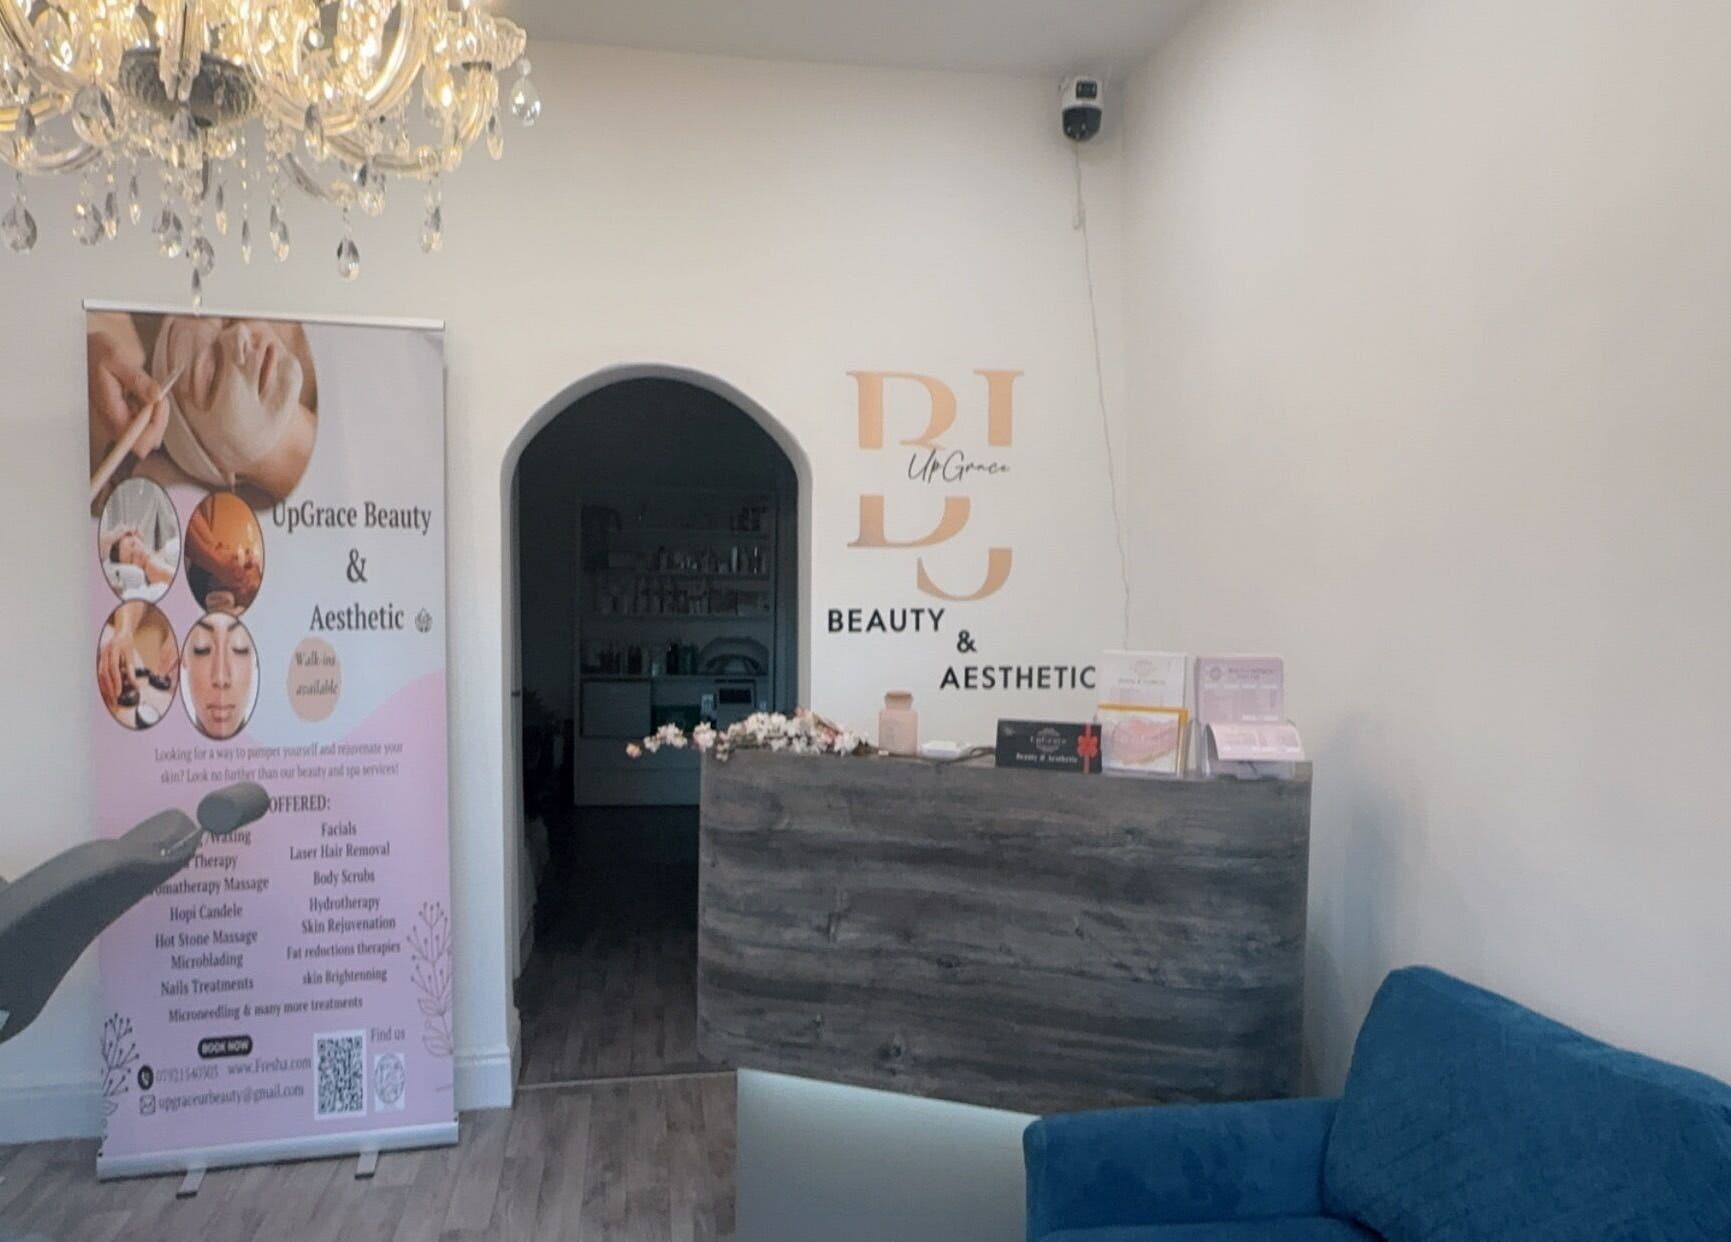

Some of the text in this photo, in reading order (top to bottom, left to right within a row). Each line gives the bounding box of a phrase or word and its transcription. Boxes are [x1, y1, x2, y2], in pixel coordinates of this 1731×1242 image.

[908, 448, 1010, 484] UpGrace
[272, 500, 432, 536] UpGrace Beauty
[346, 548, 368, 583] &
[309, 602, 404, 631] Aesthetic
[828, 608, 945, 632] BEAUTY
[956, 630, 978, 653] &
[940, 666, 1096, 690] AESTHETIC
[154, 747, 193, 764] Looking
[321, 820, 357, 837] Facials
[289, 840, 390, 861] Laser Hair Removal
[194, 854, 239, 871] Therapy
[224, 876, 270, 893] Massage
[313, 867, 376, 888] Body Scrubs
[309, 895, 380, 913] Hydrotherapy
[169, 905, 197, 924] Hopi
[302, 915, 396, 934] Skin Rejuvenation
[155, 929, 258, 949] Hot Stone Massage
[171, 951, 244, 969] Microblading
[161, 977, 254, 997] Nails Treatments
[254, 1002, 282, 1018] many
[284, 1000, 309, 1014] more
[311, 996, 364, 1012] treatments
[371, 1026, 405, 1041] Find us
